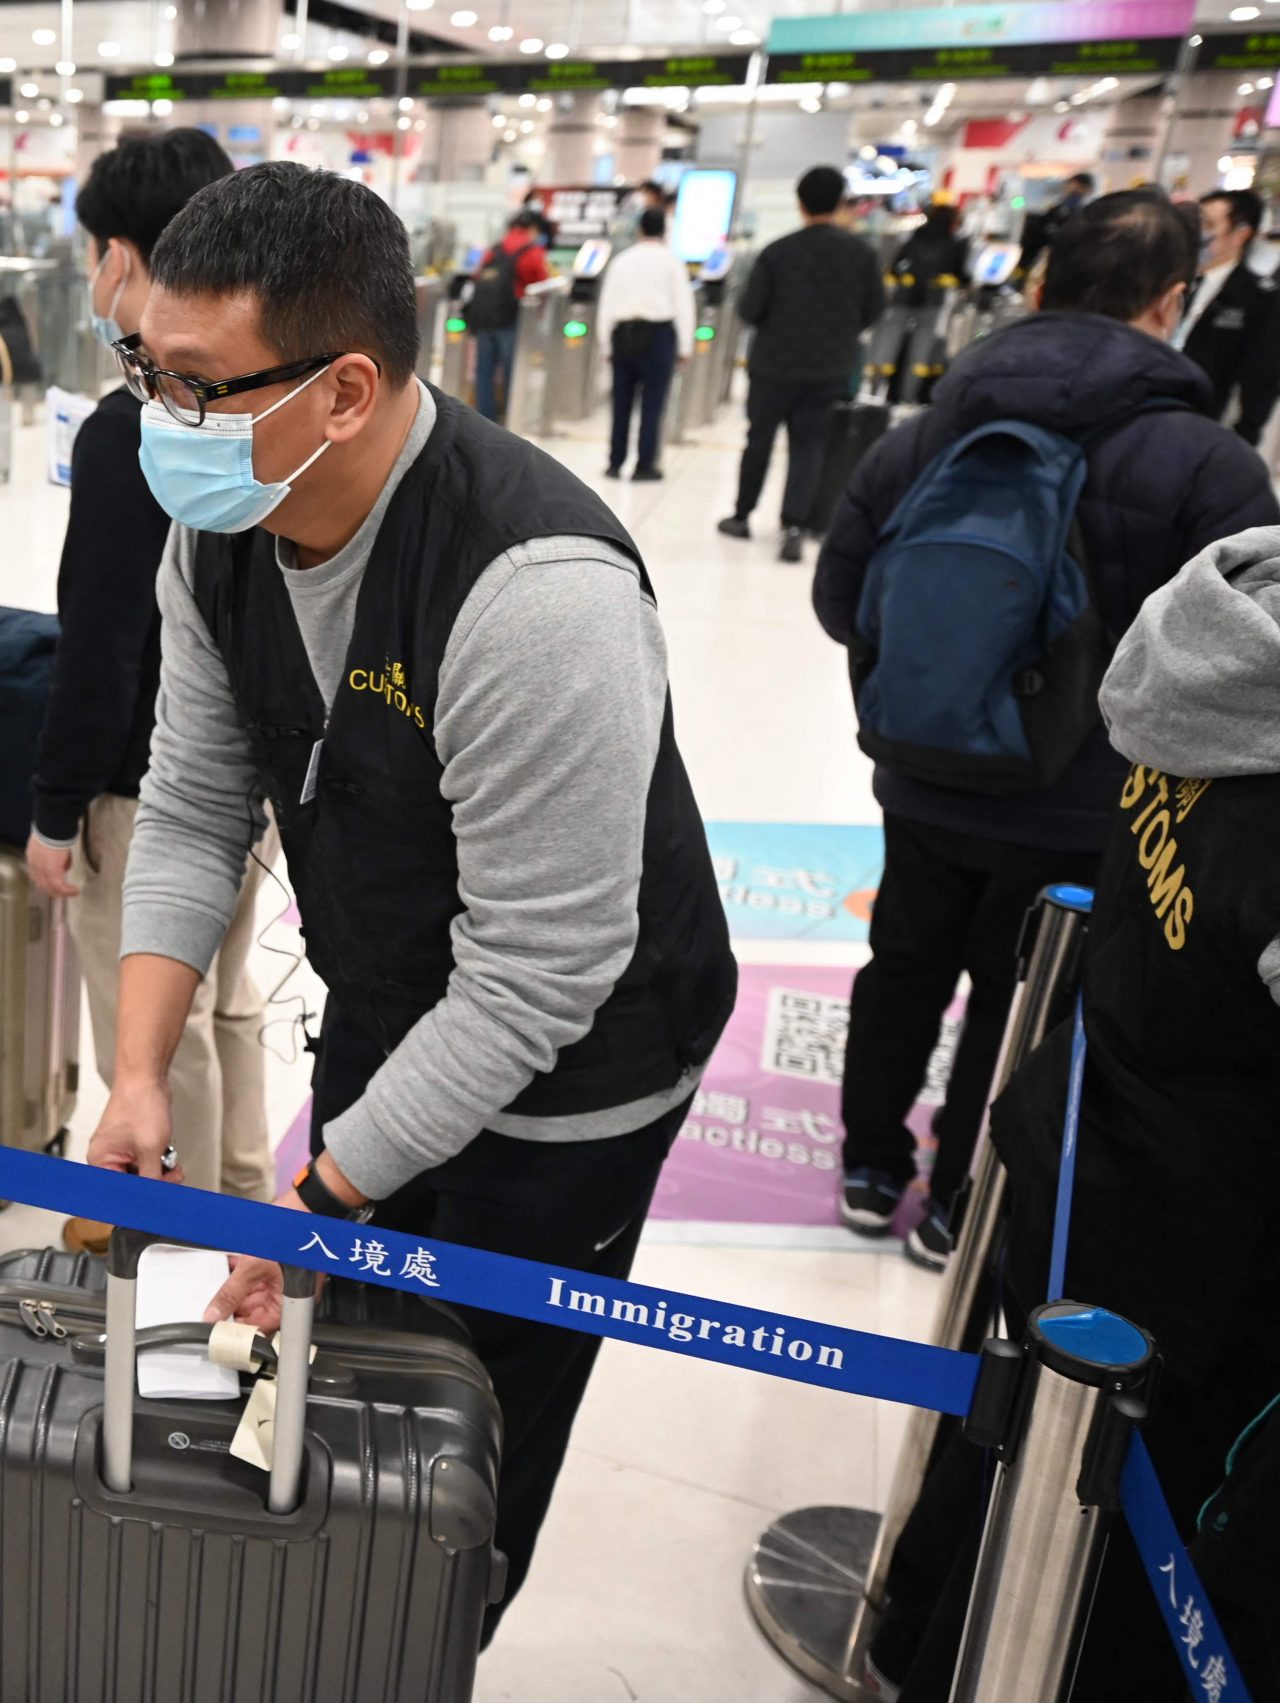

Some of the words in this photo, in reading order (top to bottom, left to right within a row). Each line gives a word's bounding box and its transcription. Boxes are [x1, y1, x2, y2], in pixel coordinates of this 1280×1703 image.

[298, 1230, 441, 1289] 入境處
[546, 1276, 846, 1371] Immigration
